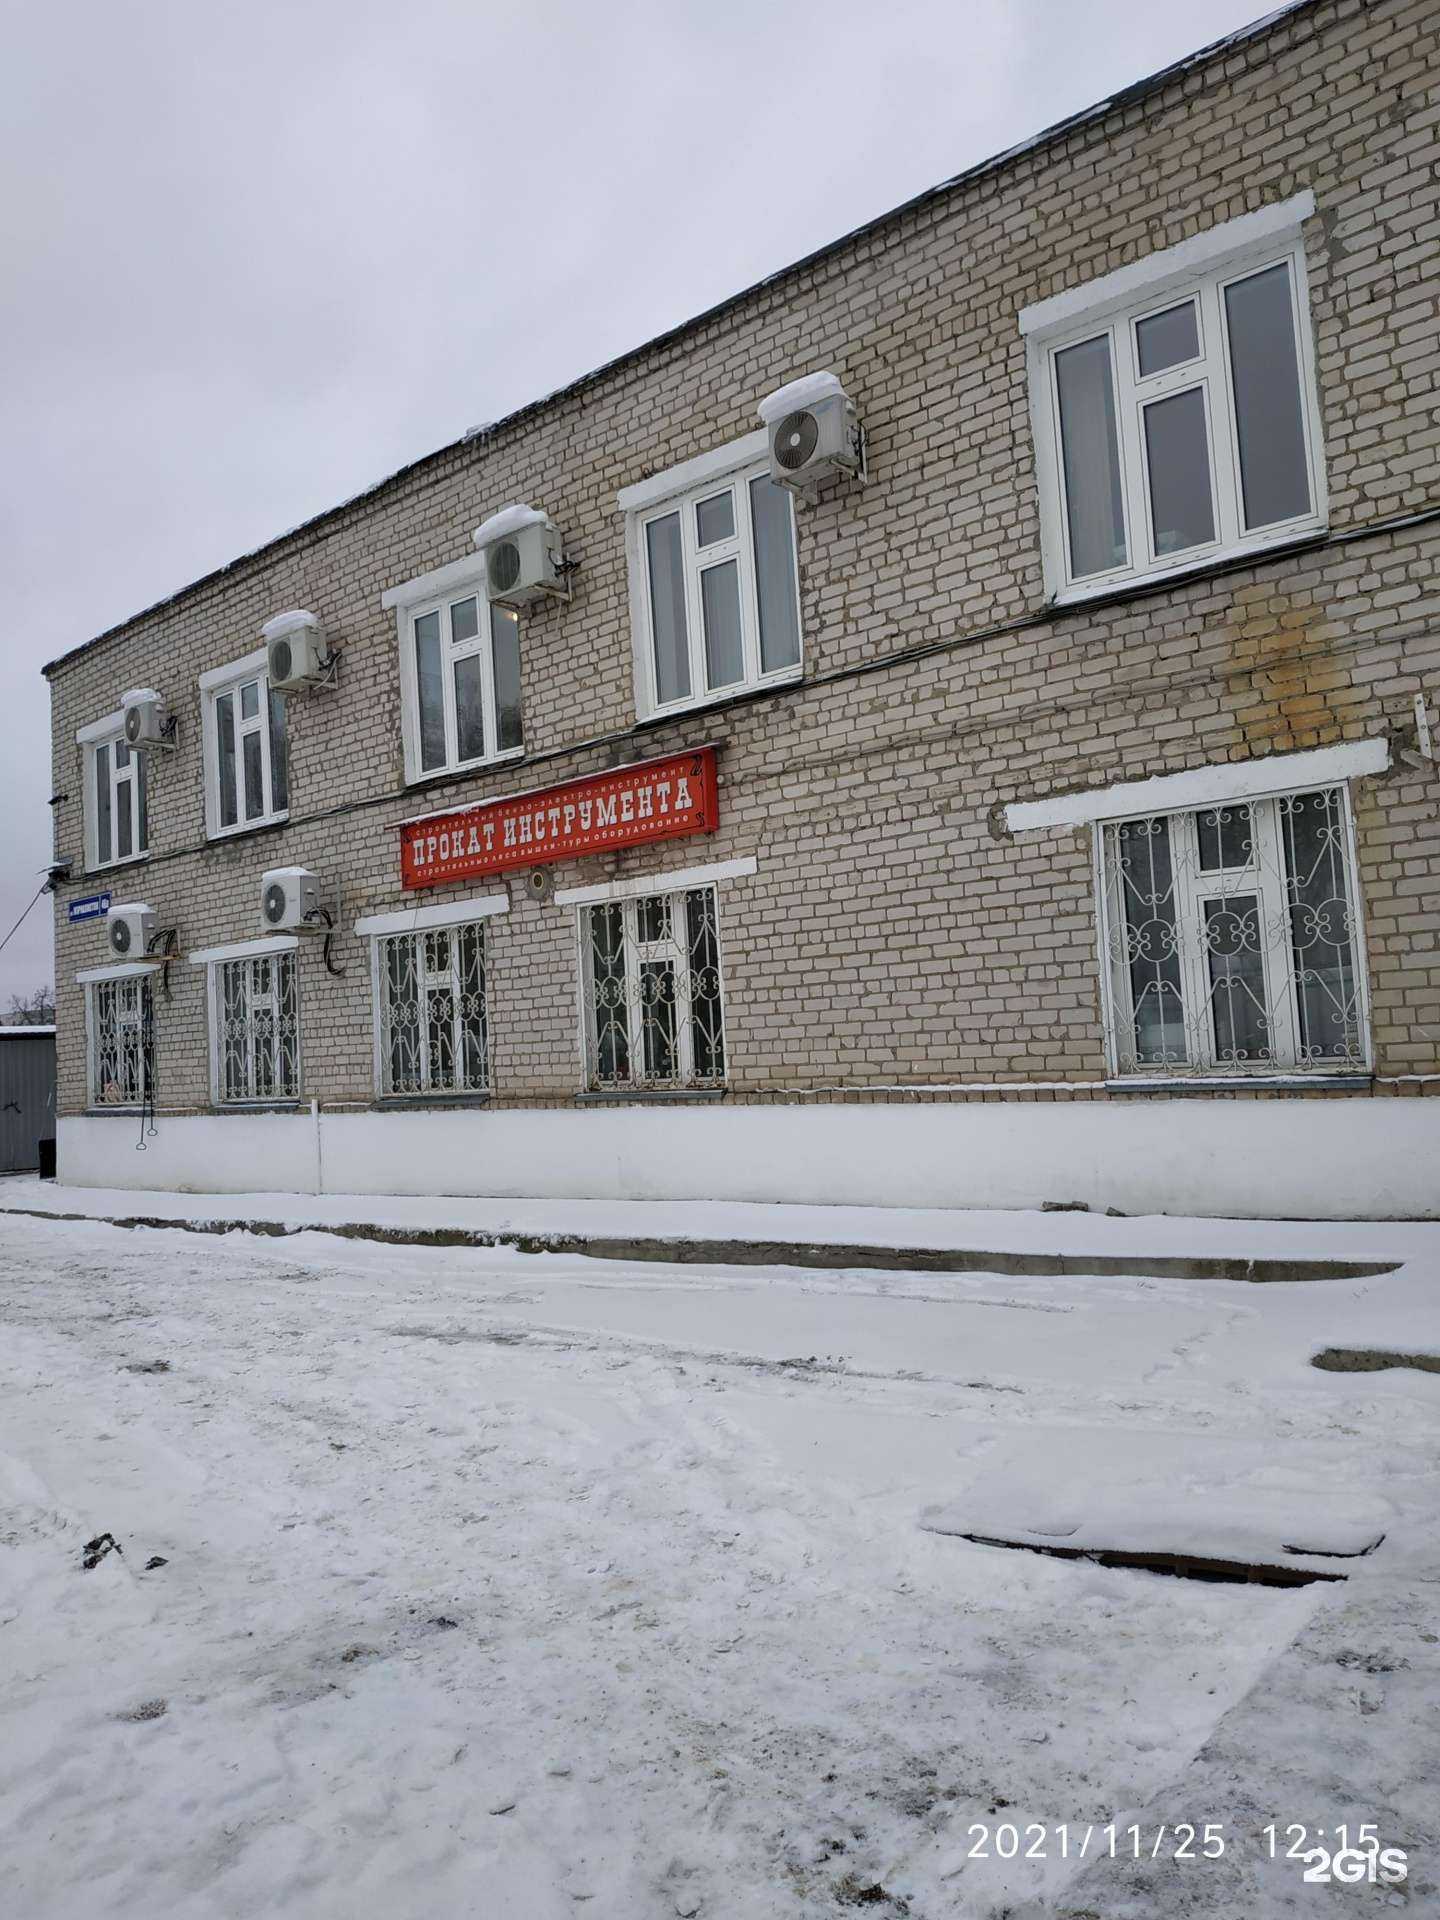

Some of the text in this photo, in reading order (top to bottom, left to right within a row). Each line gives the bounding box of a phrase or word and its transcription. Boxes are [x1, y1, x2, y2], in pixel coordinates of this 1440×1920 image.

[412, 777, 693, 867] ПРОКАТ ИНСТРУМЕНТА
[594, 814, 689, 841] оборудование
